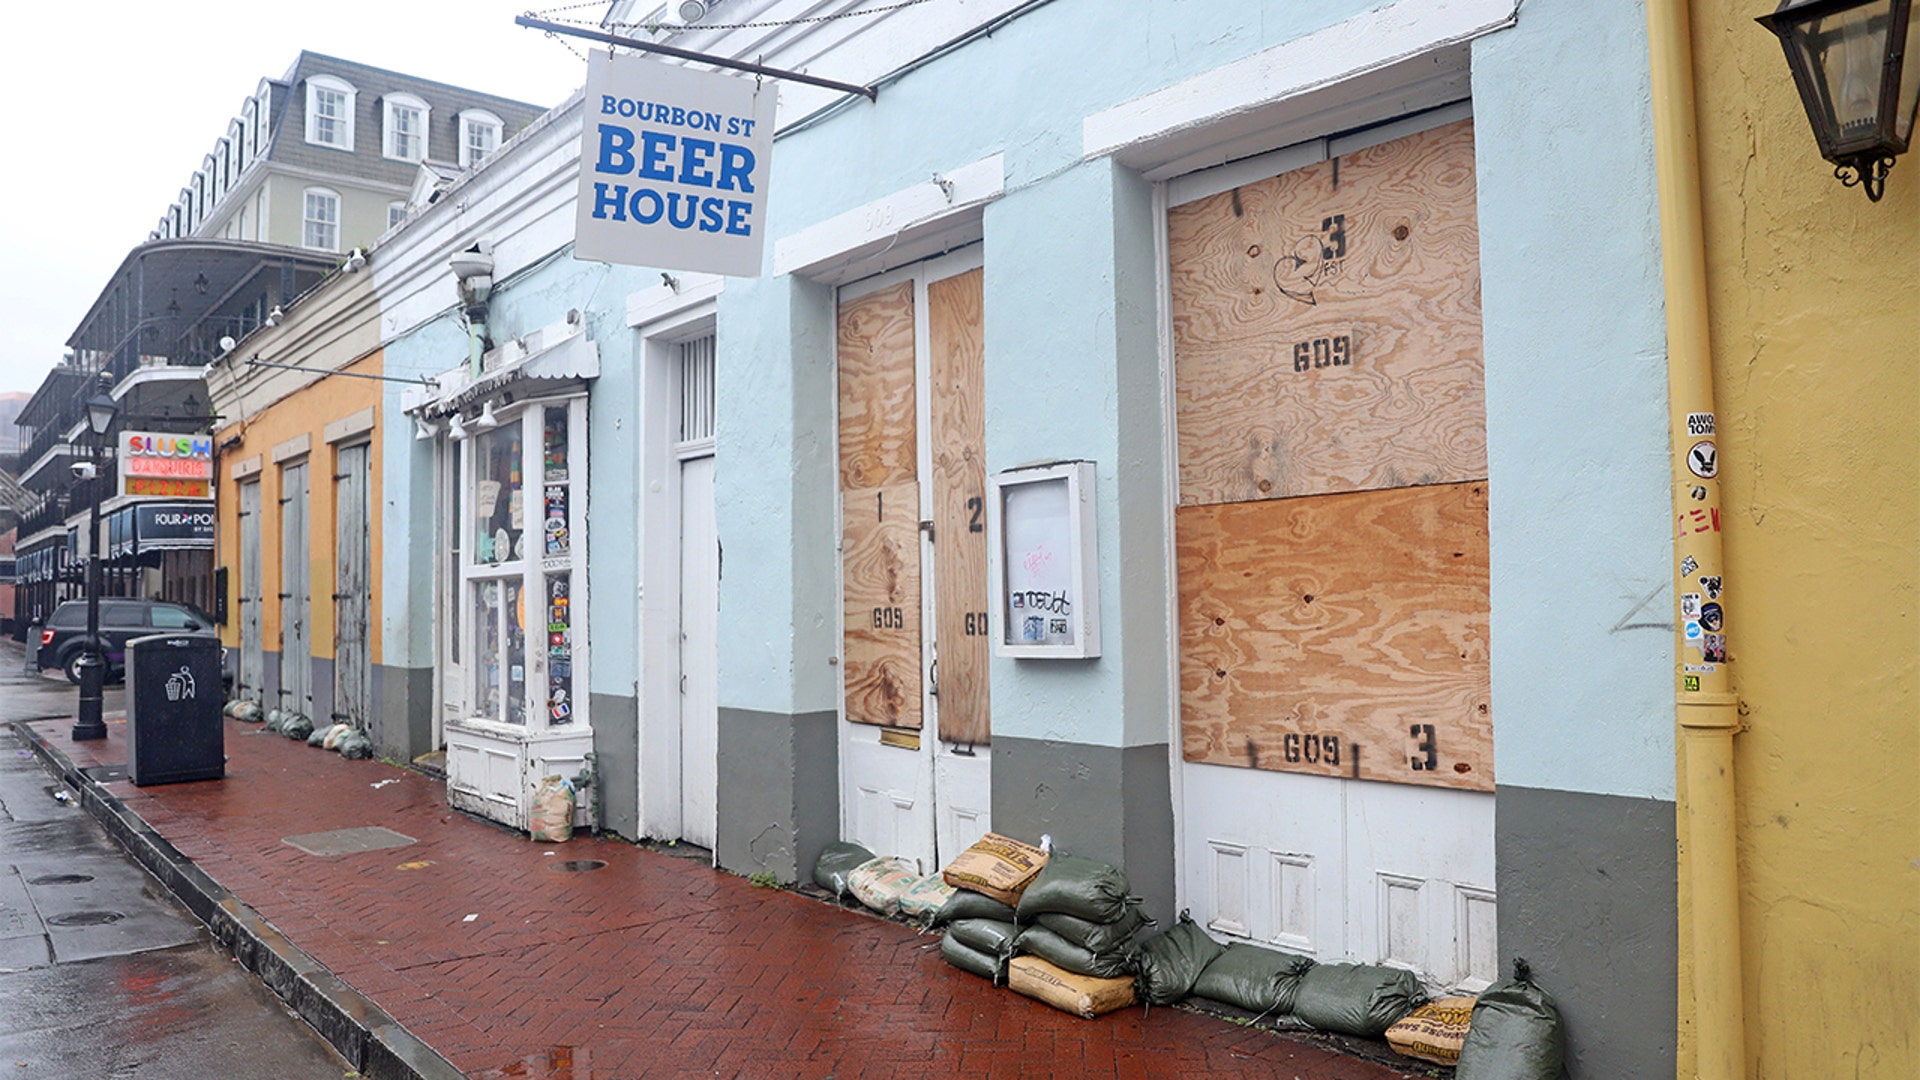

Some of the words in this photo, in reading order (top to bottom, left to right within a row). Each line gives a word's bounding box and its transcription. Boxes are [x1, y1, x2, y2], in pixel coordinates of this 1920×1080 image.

[601, 95, 722, 132] BOURBON
[727, 117, 755, 137] ST
[595, 123, 756, 193] BEER
[592, 182, 753, 236] HOUSE
[1322, 214, 1346, 260] 3
[1294, 336, 1350, 372] 609
[129, 435, 210, 458] SLUSH
[135, 479, 200, 496] PIZZA
[155, 513, 182, 525] FOUR
[876, 491, 883, 523] 1
[967, 496, 983, 534] 2
[873, 607, 904, 629] 609
[1284, 733, 1340, 766] 609
[1410, 724, 1437, 771] 3
